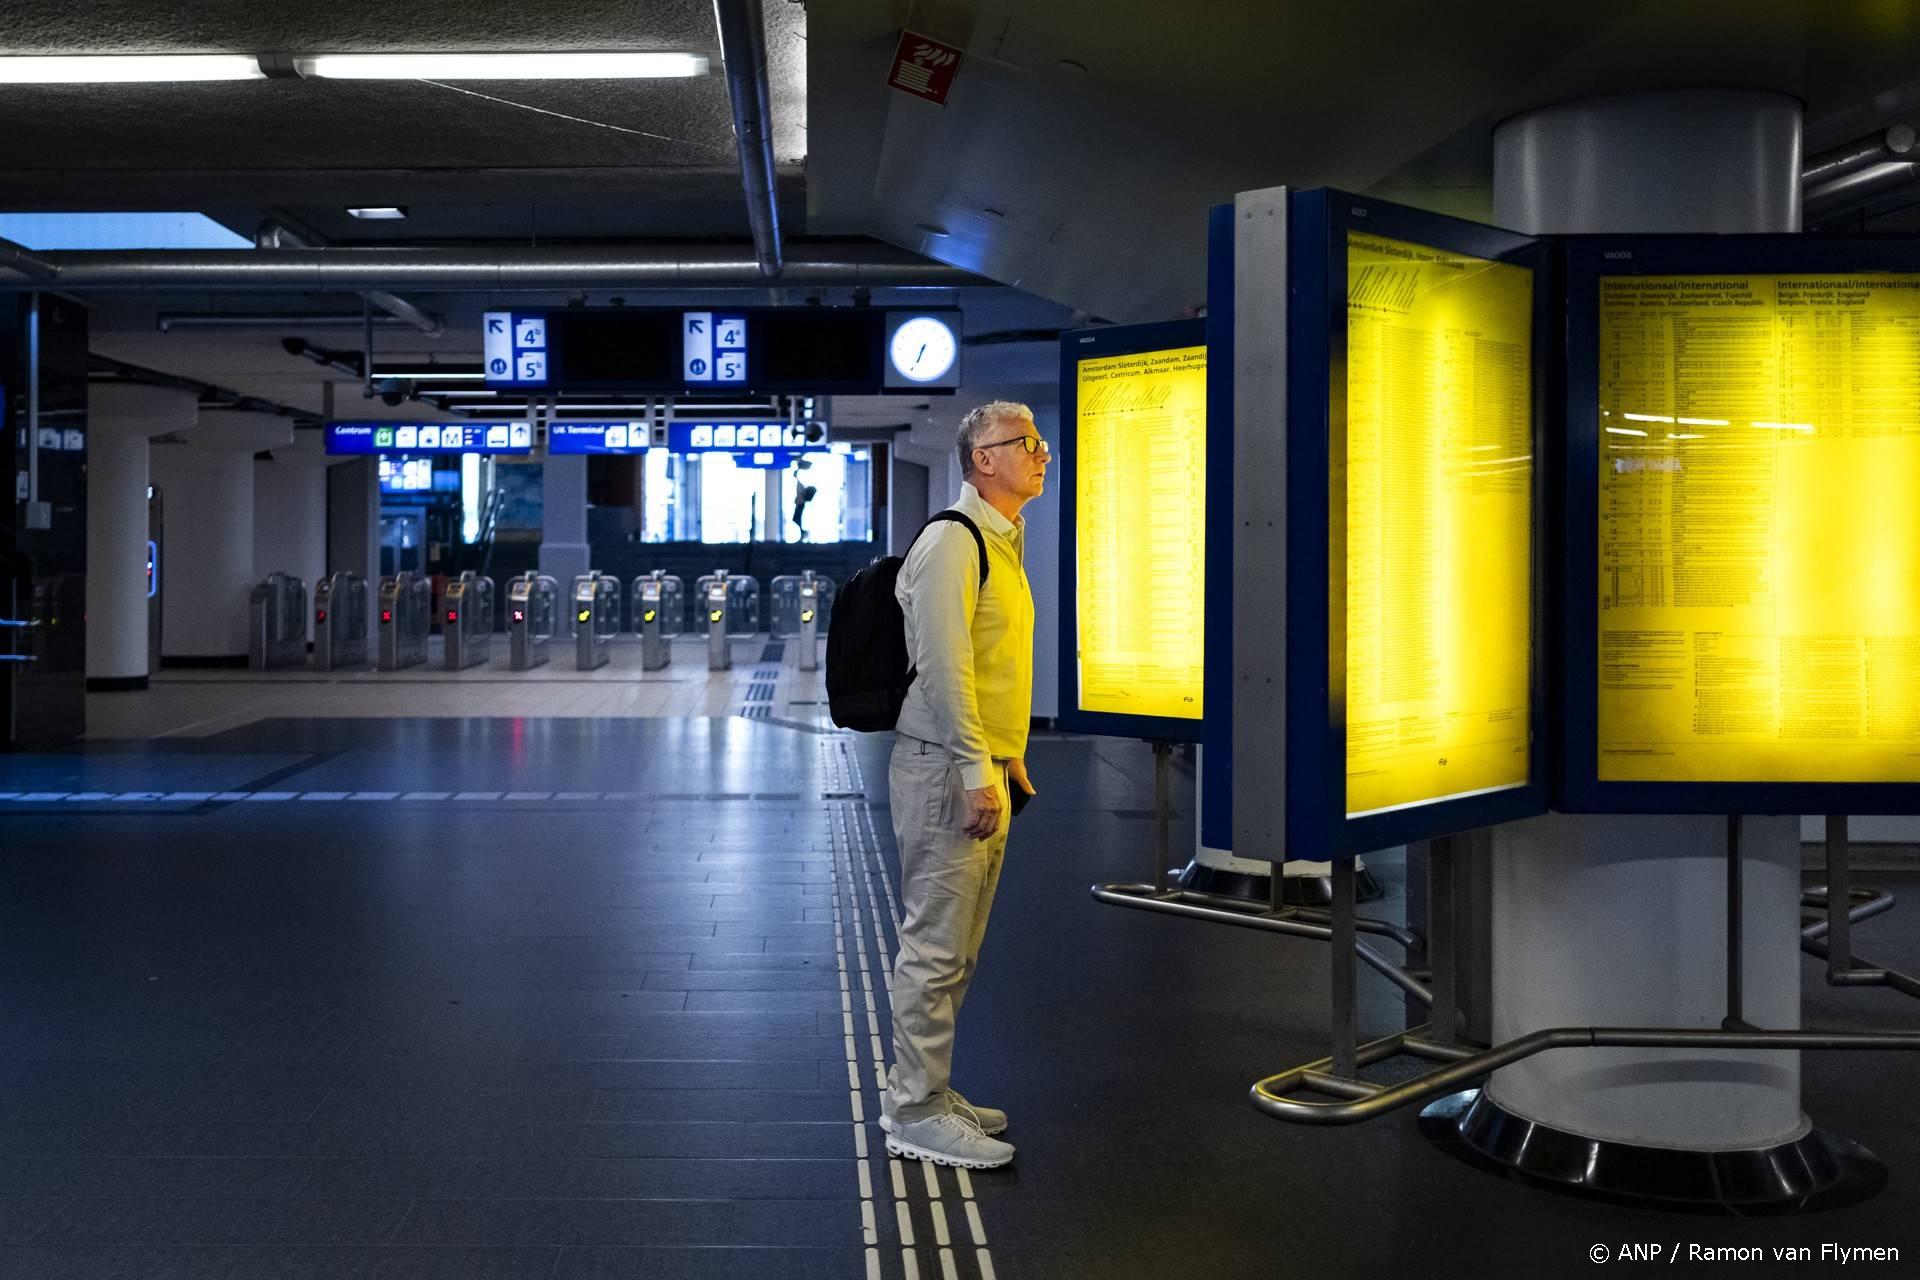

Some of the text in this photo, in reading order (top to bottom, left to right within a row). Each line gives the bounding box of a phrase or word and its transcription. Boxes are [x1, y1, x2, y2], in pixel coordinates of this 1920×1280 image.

[1603, 281, 1749, 290] Internationaal/International
[1082, 364, 1117, 373] Amsterdam
[334, 425, 372, 435] Centrum
